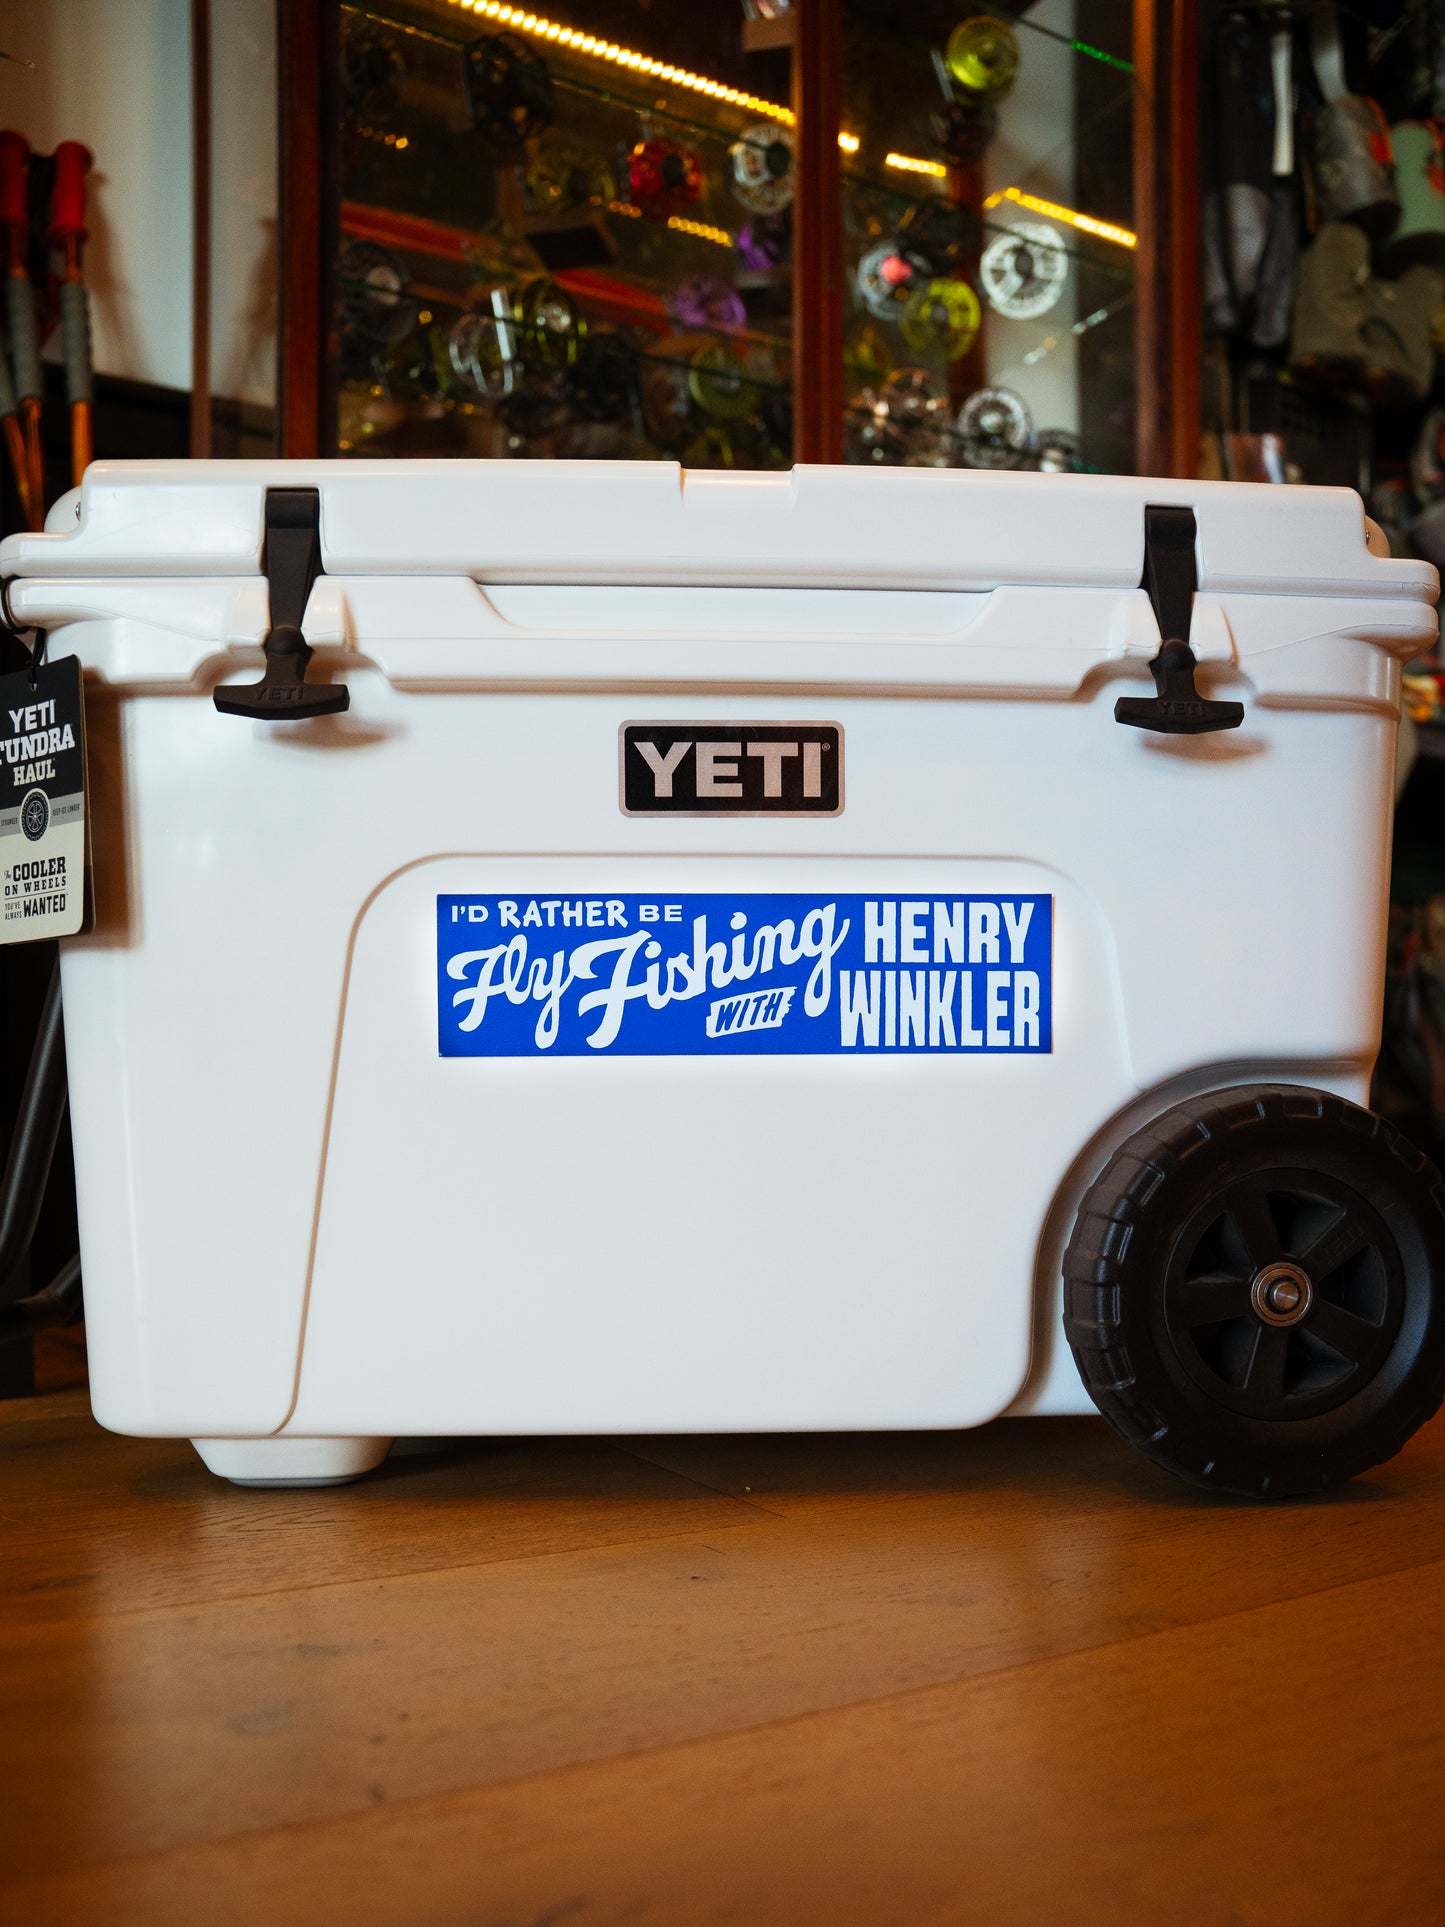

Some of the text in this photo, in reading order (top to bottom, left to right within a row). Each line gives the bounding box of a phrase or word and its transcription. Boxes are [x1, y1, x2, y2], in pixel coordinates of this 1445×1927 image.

[8, 699, 56, 733] YETI
[13, 759, 56, 786] HAUL
[633, 741, 822, 797] YETI
[4, 875, 67, 896] ON WHEELS
[13, 856, 66, 882] COOLER
[23, 893, 66, 918] WANTED
[452, 900, 683, 928] I'D RATHER BE
[864, 901, 1035, 964] HENRY
[446, 902, 851, 1050] Fly Fishing
[714, 989, 785, 1034] WITH
[839, 970, 1040, 1047] WINKLER
